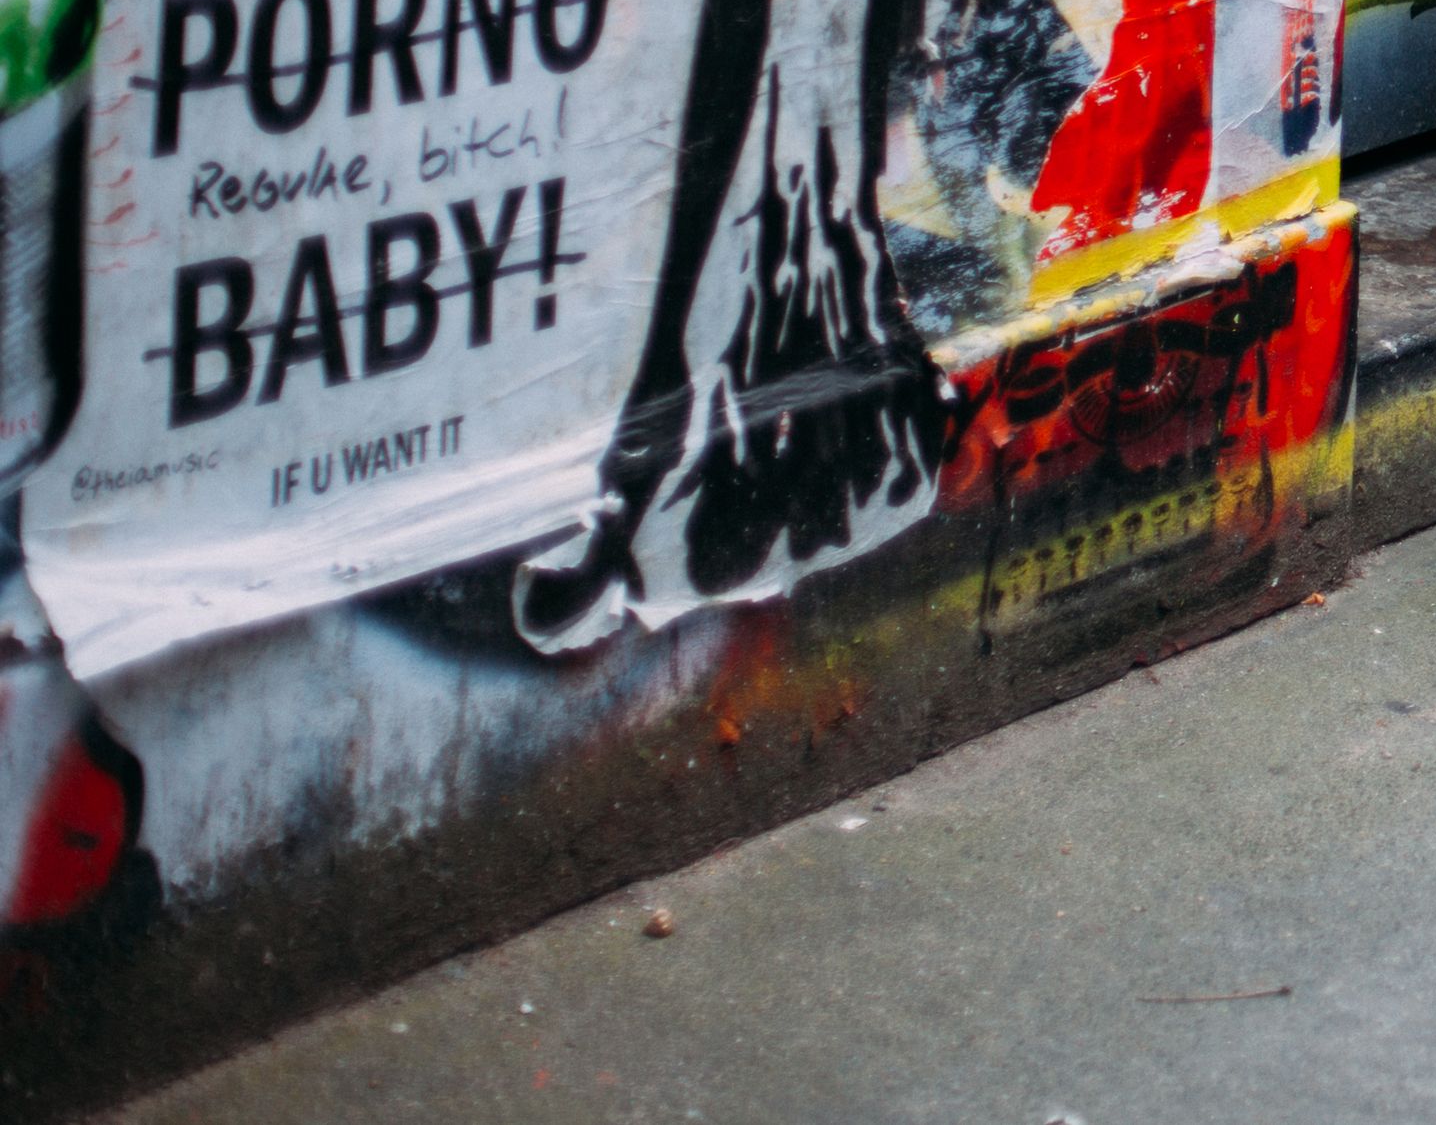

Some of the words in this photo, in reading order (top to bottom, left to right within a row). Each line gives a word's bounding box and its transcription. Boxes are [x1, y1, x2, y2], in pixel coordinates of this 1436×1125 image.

[167, 177, 567, 430] BABY!
[272, 461, 303, 508] IF
[311, 453, 333, 495] U
[341, 424, 432, 486] WANT
[439, 415, 465, 458] IT
